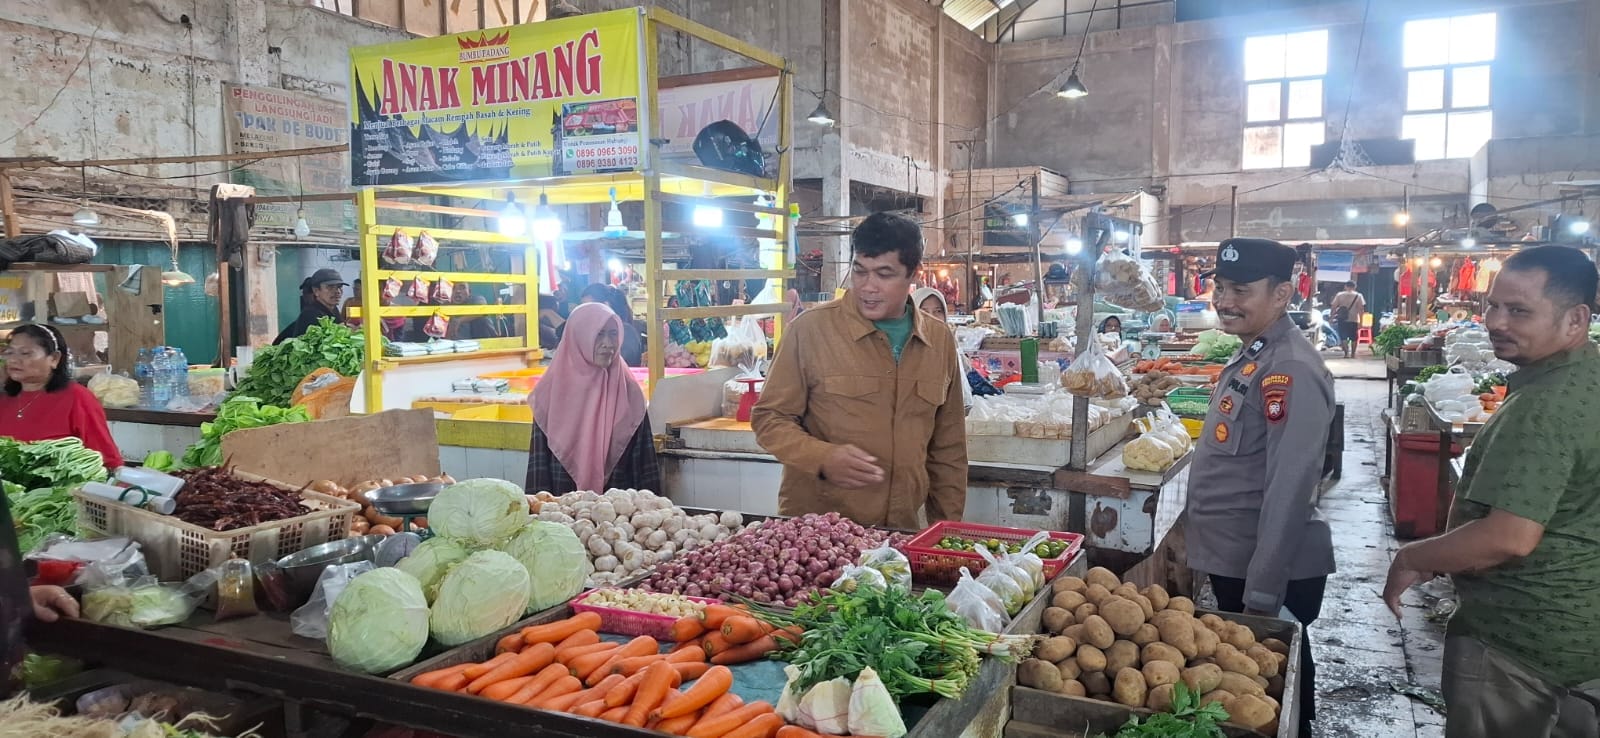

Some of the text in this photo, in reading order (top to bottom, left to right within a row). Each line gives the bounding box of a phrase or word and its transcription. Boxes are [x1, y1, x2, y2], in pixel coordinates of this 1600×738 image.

[380, 29, 601, 114] ANAK MINANG
[233, 88, 315, 111] PENGGILINGAN
[255, 103, 311, 121] LANGSUNG
[312, 113, 333, 125] JADI
[363, 120, 391, 131] Menjual
[421, 115, 445, 124] Macam
[446, 112, 474, 122] Rempah
[475, 111, 496, 119] Basah
[506, 108, 531, 117] Kering
[283, 120, 301, 135] DE
[576, 145, 638, 159] 0896 0965 3090
[577, 157, 638, 169] 0896 9380 4123
